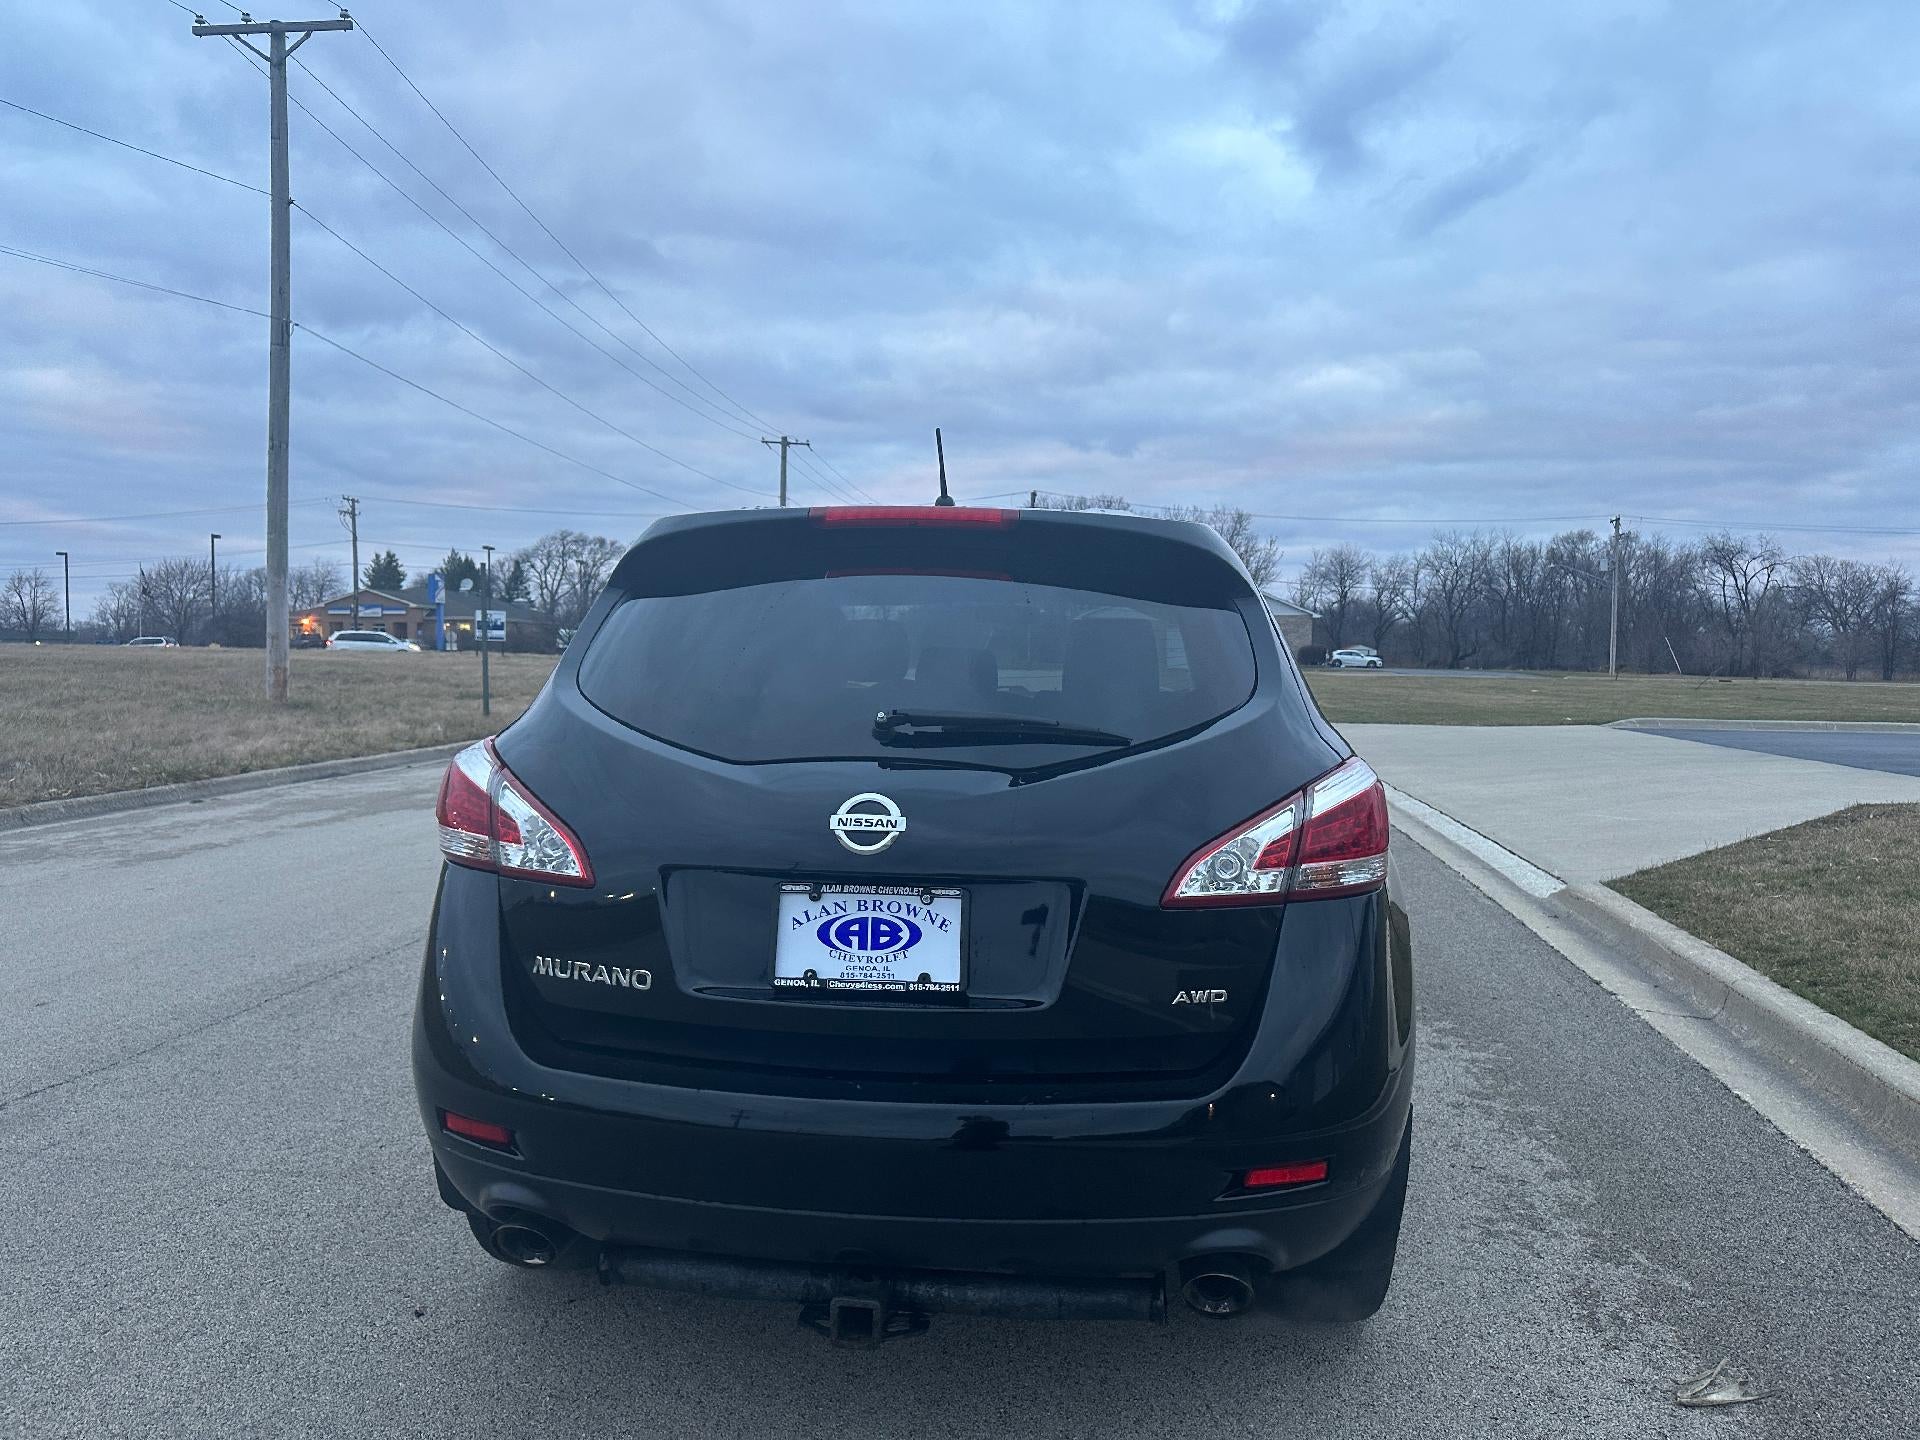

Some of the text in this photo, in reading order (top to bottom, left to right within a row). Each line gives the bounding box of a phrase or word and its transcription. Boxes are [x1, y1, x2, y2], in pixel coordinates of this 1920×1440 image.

[837, 818, 898, 829] NISSAN
[821, 884, 841, 893] ALAN
[843, 885, 876, 894] BROWNE
[878, 886, 923, 895] CHEVROLET
[791, 899, 952, 933] ALAN BROWNE
[834, 916, 904, 951] AB
[829, 949, 909, 964] CHEVROLET
[533, 955, 652, 991] MURANO
[840, 971, 895, 980] 815-784-2511
[774, 979, 820, 988] GENOA, IL
[828, 980, 904, 990] Chevys4less.com
[909, 983, 960, 991] 815-784-2511
[1172, 989, 1228, 1004] AWD
